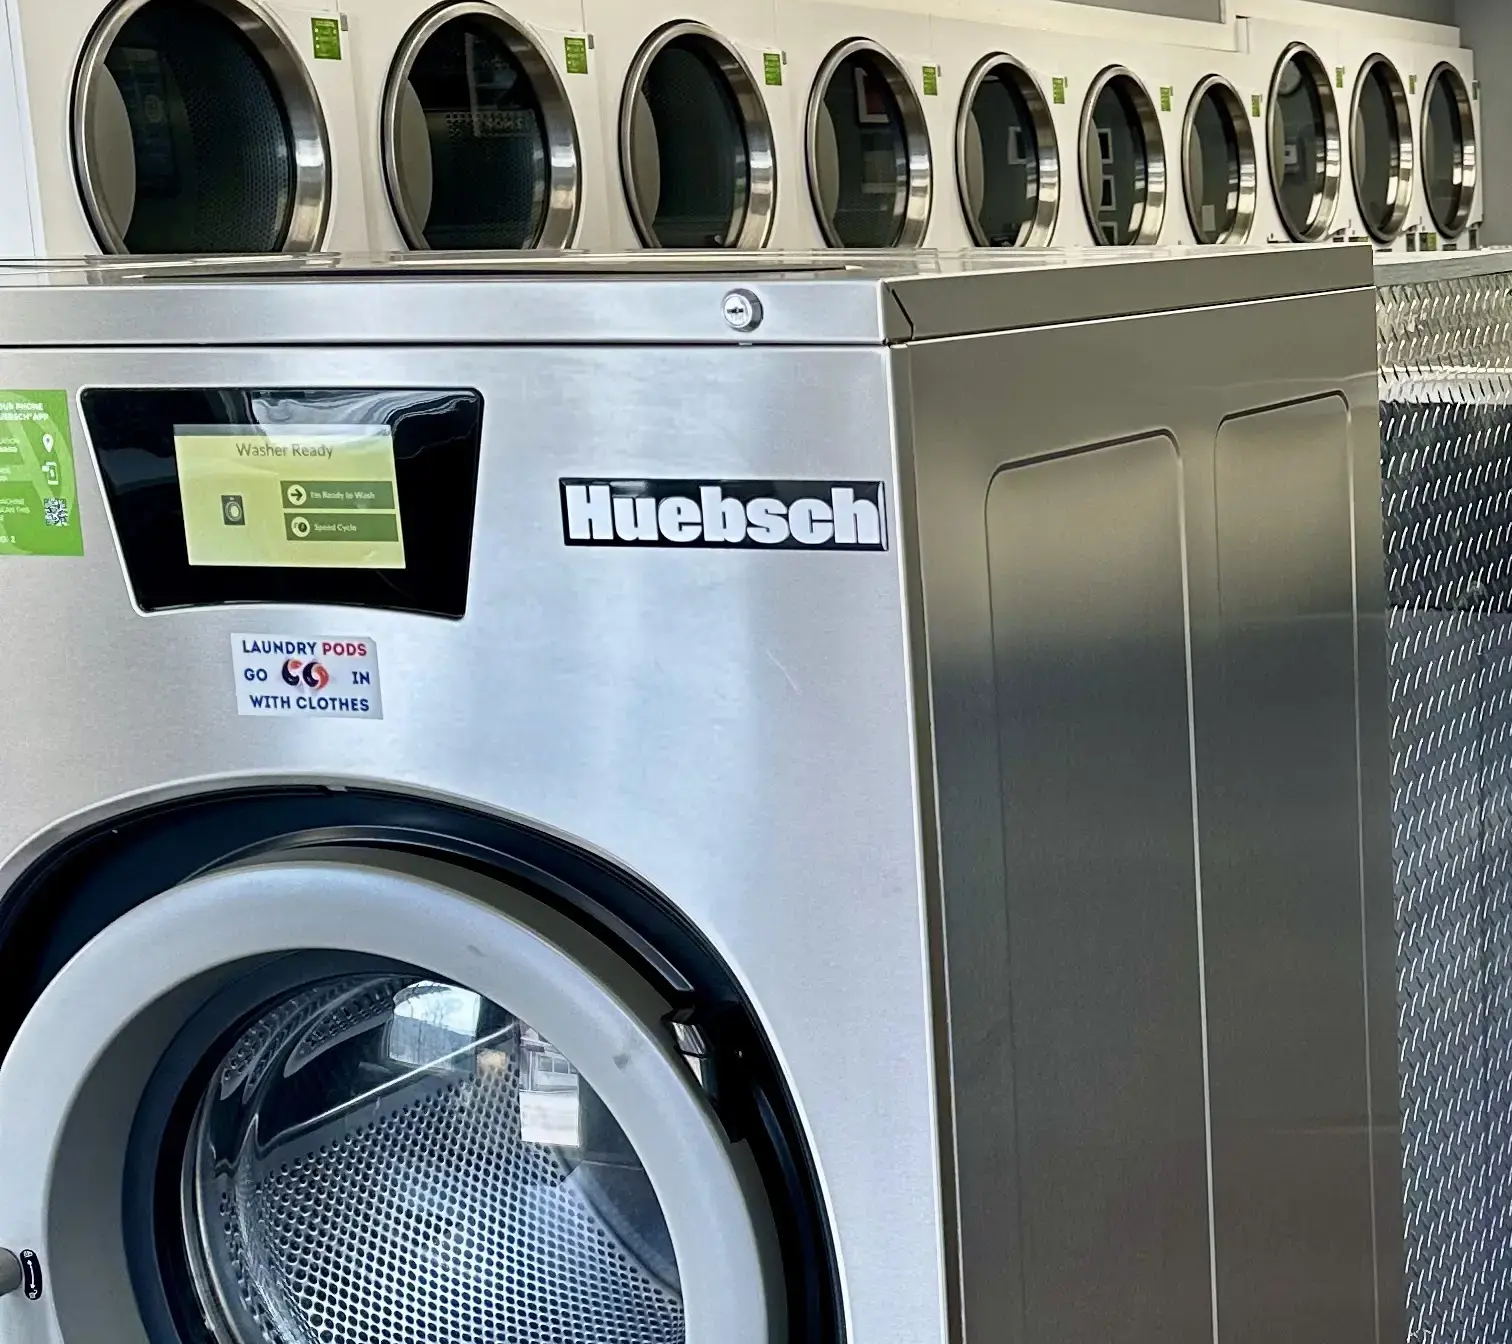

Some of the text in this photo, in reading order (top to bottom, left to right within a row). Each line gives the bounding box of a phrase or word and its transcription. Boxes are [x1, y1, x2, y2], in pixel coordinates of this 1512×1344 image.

[236, 443, 333, 459] Washer Ready
[322, 491, 344, 500] Ready
[354, 491, 375, 499] Wash
[565, 483, 880, 545] Huebsch
[314, 523, 356, 532] Speed Cycle
[242, 640, 367, 656] LAUNDRY PODS
[244, 668, 370, 685] GO IN
[249, 695, 369, 712] WITH CLOTHES
